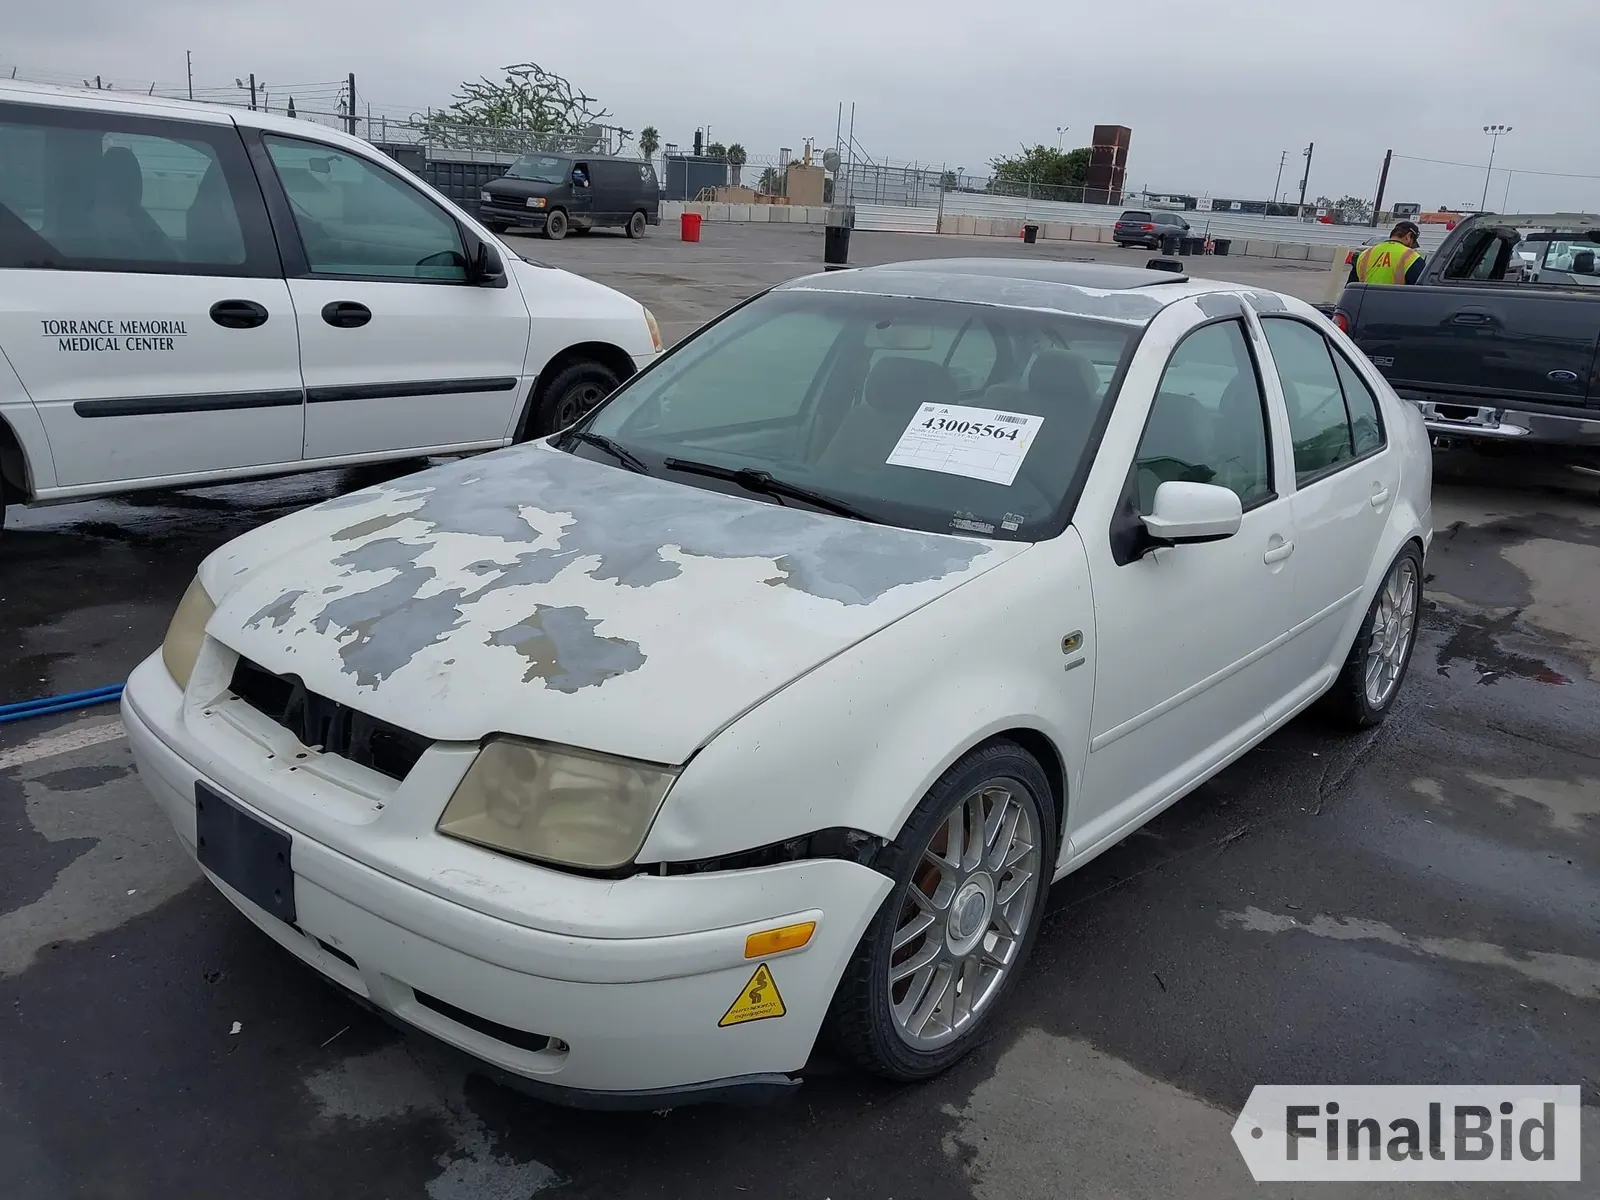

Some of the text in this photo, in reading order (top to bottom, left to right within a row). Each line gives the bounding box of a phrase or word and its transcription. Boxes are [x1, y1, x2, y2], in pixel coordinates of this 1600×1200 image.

[41, 319, 187, 334] TORRANCE MEMORIAL
[59, 337, 174, 351] MEDICAL CENTER
[922, 417, 1020, 441] 43005564
